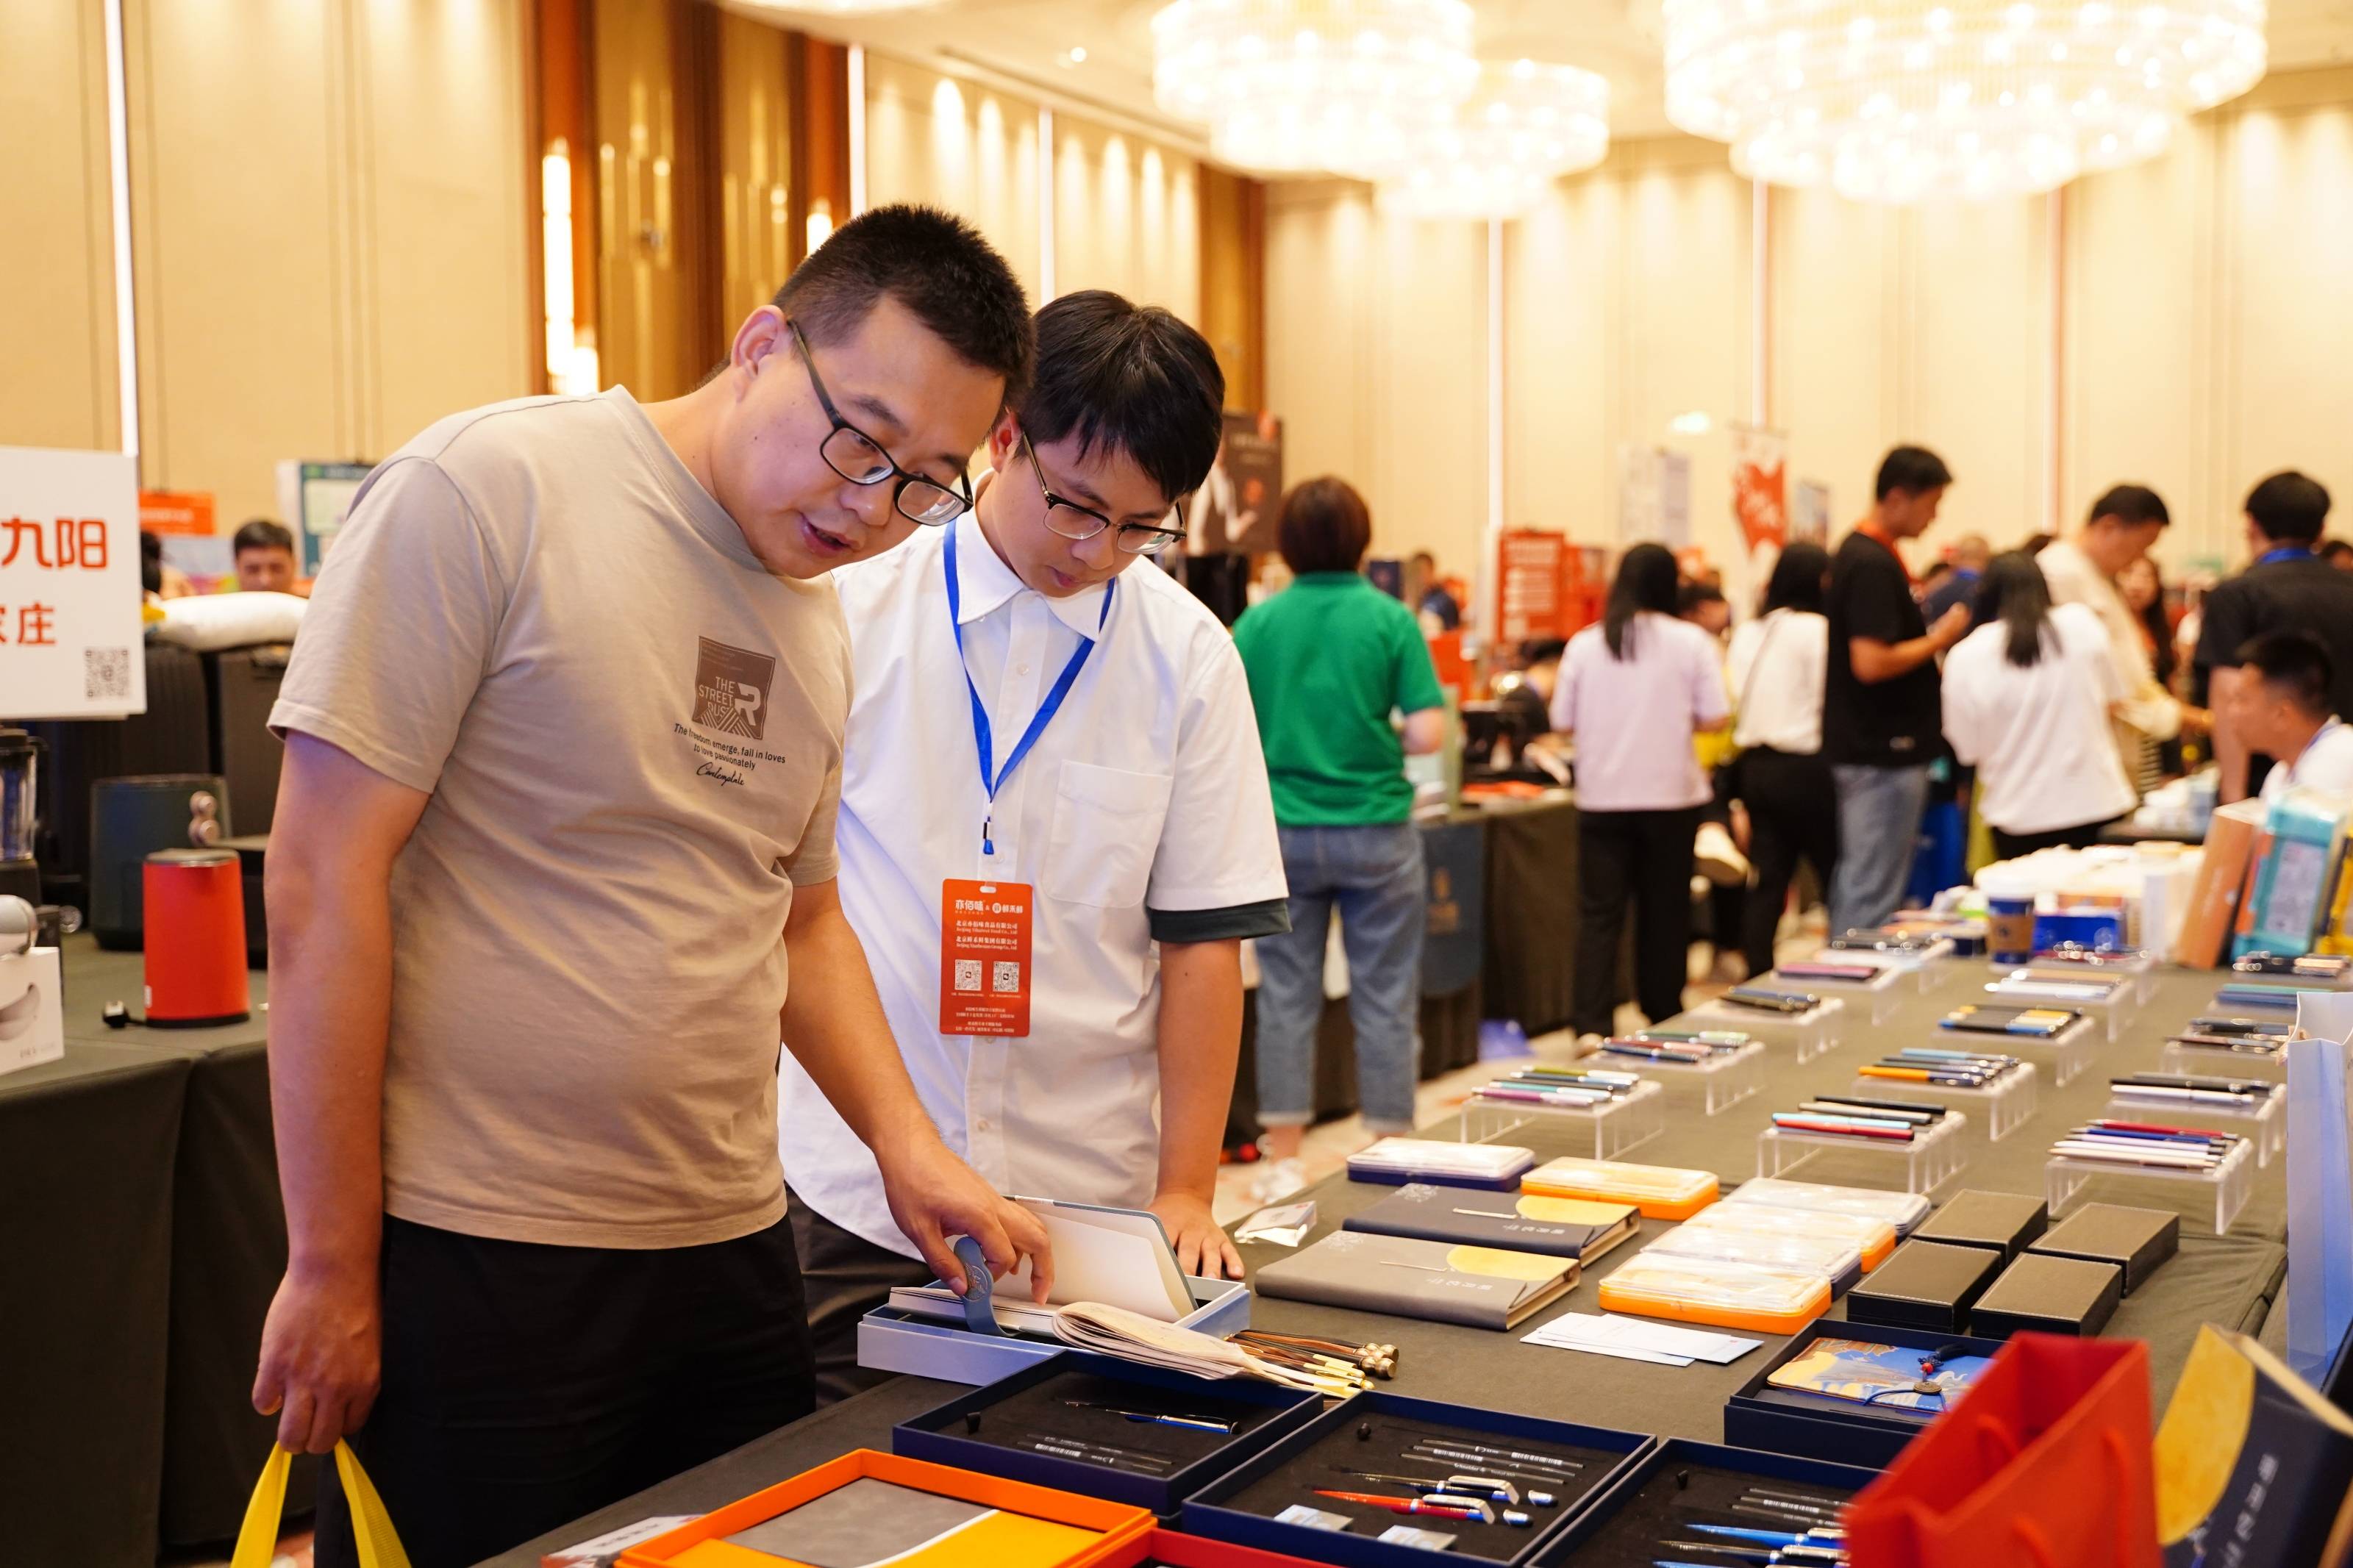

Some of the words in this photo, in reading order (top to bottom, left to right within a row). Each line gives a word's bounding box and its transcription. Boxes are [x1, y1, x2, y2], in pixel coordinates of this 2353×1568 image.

[1, 518, 107, 569] 九阳
[0, 603, 56, 645] 庄
[699, 684, 734, 706] STREET
[715, 676, 735, 694] THE
[674, 723, 688, 735] The
[713, 740, 740, 755] emerge,
[741, 746, 754, 758] fall
[756, 750, 763, 759] in
[765, 751, 786, 764] loves
[694, 744, 701, 753] to
[701, 745, 713, 758] love
[714, 751, 756, 770] passionately
